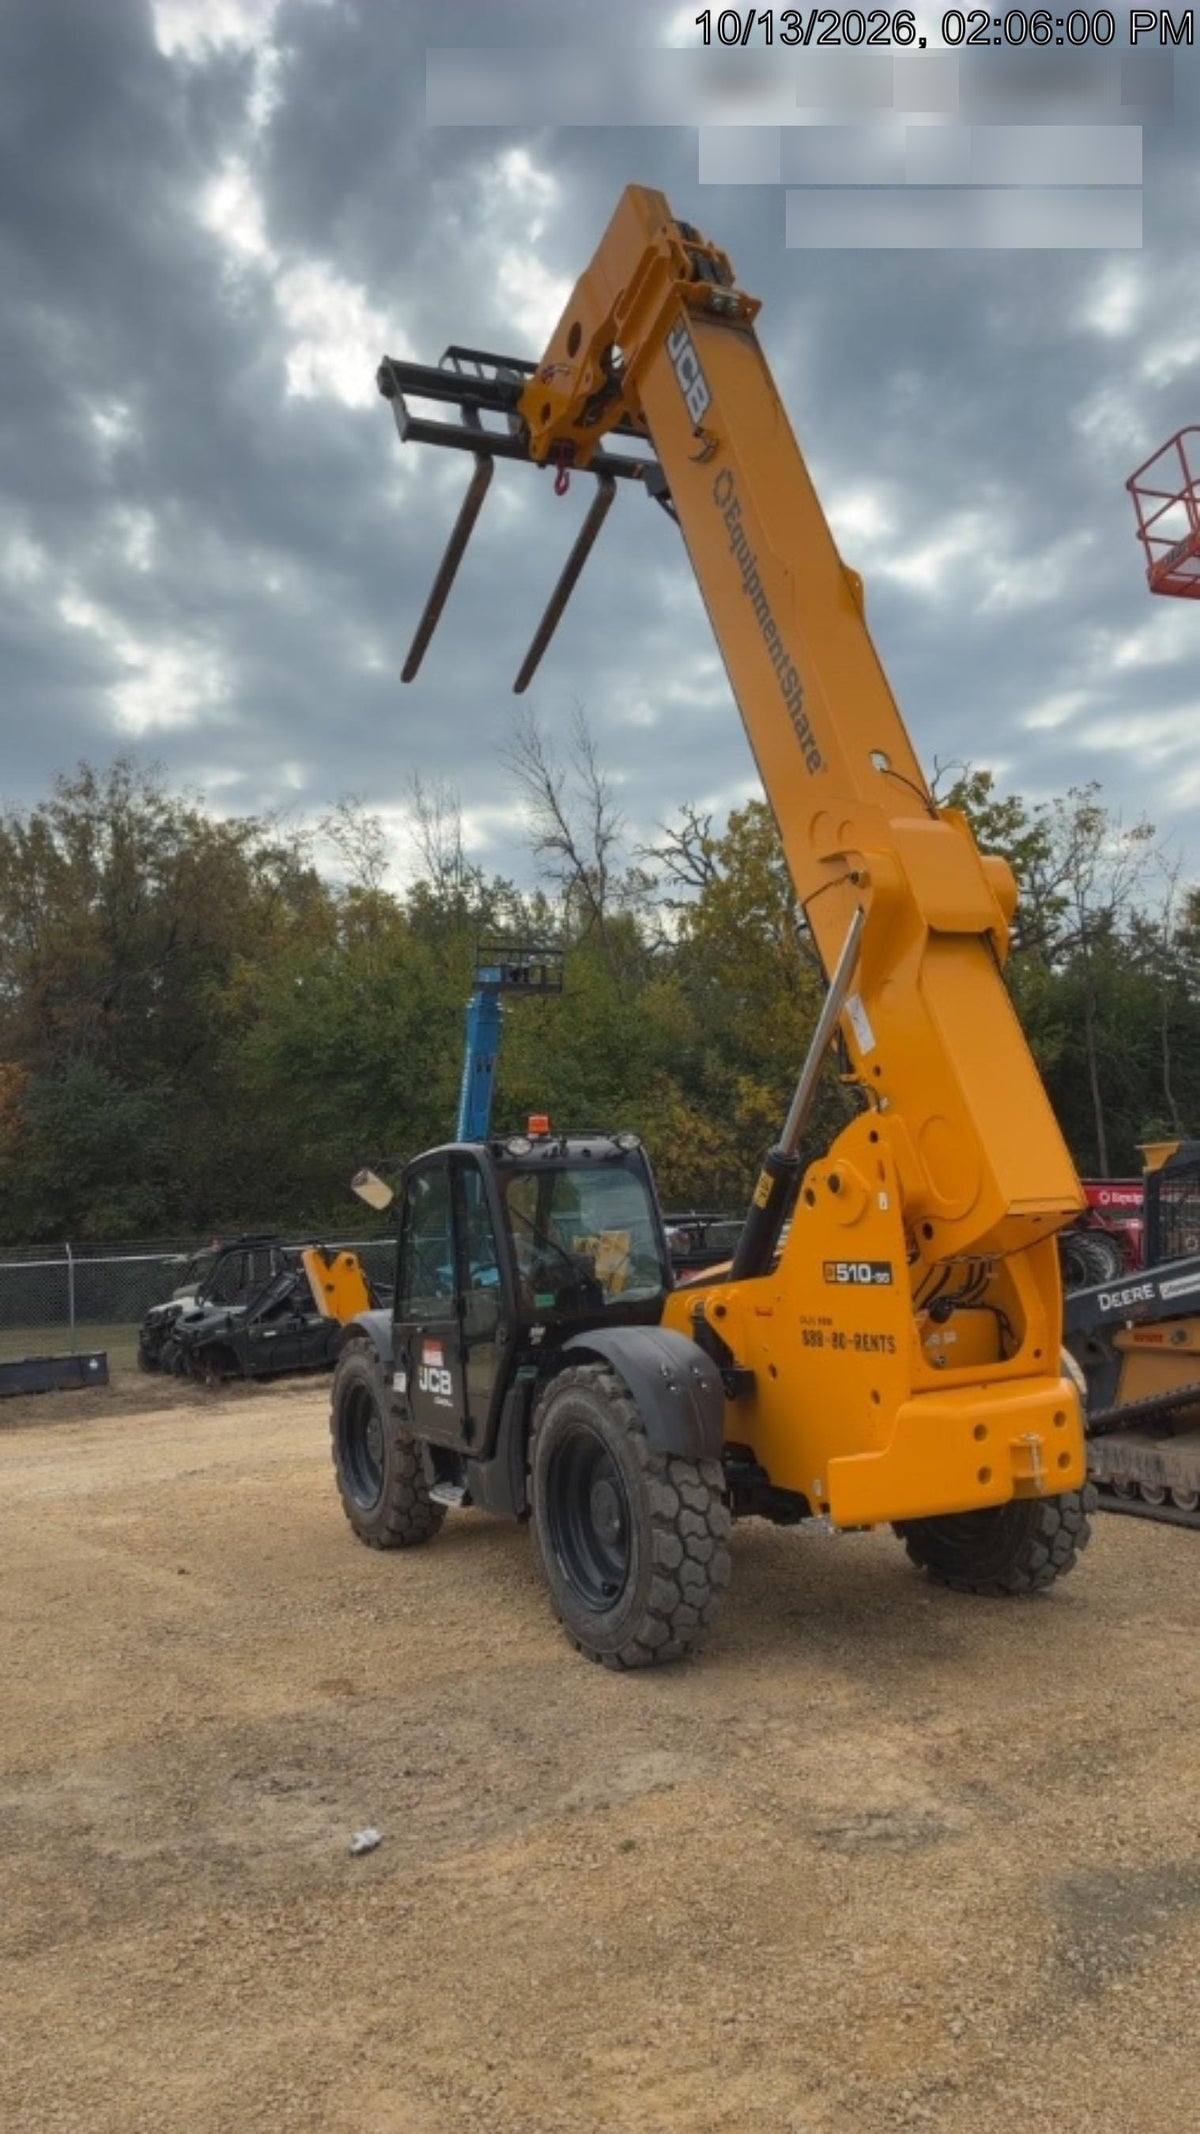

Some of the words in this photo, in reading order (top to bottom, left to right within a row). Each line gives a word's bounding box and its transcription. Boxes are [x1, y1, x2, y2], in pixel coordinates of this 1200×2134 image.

[667, 322, 710, 425] JCB
[719, 502, 822, 776] EquipmentShare
[1098, 1283, 1156, 1312] DEERE
[419, 1366, 452, 1395] JCB
